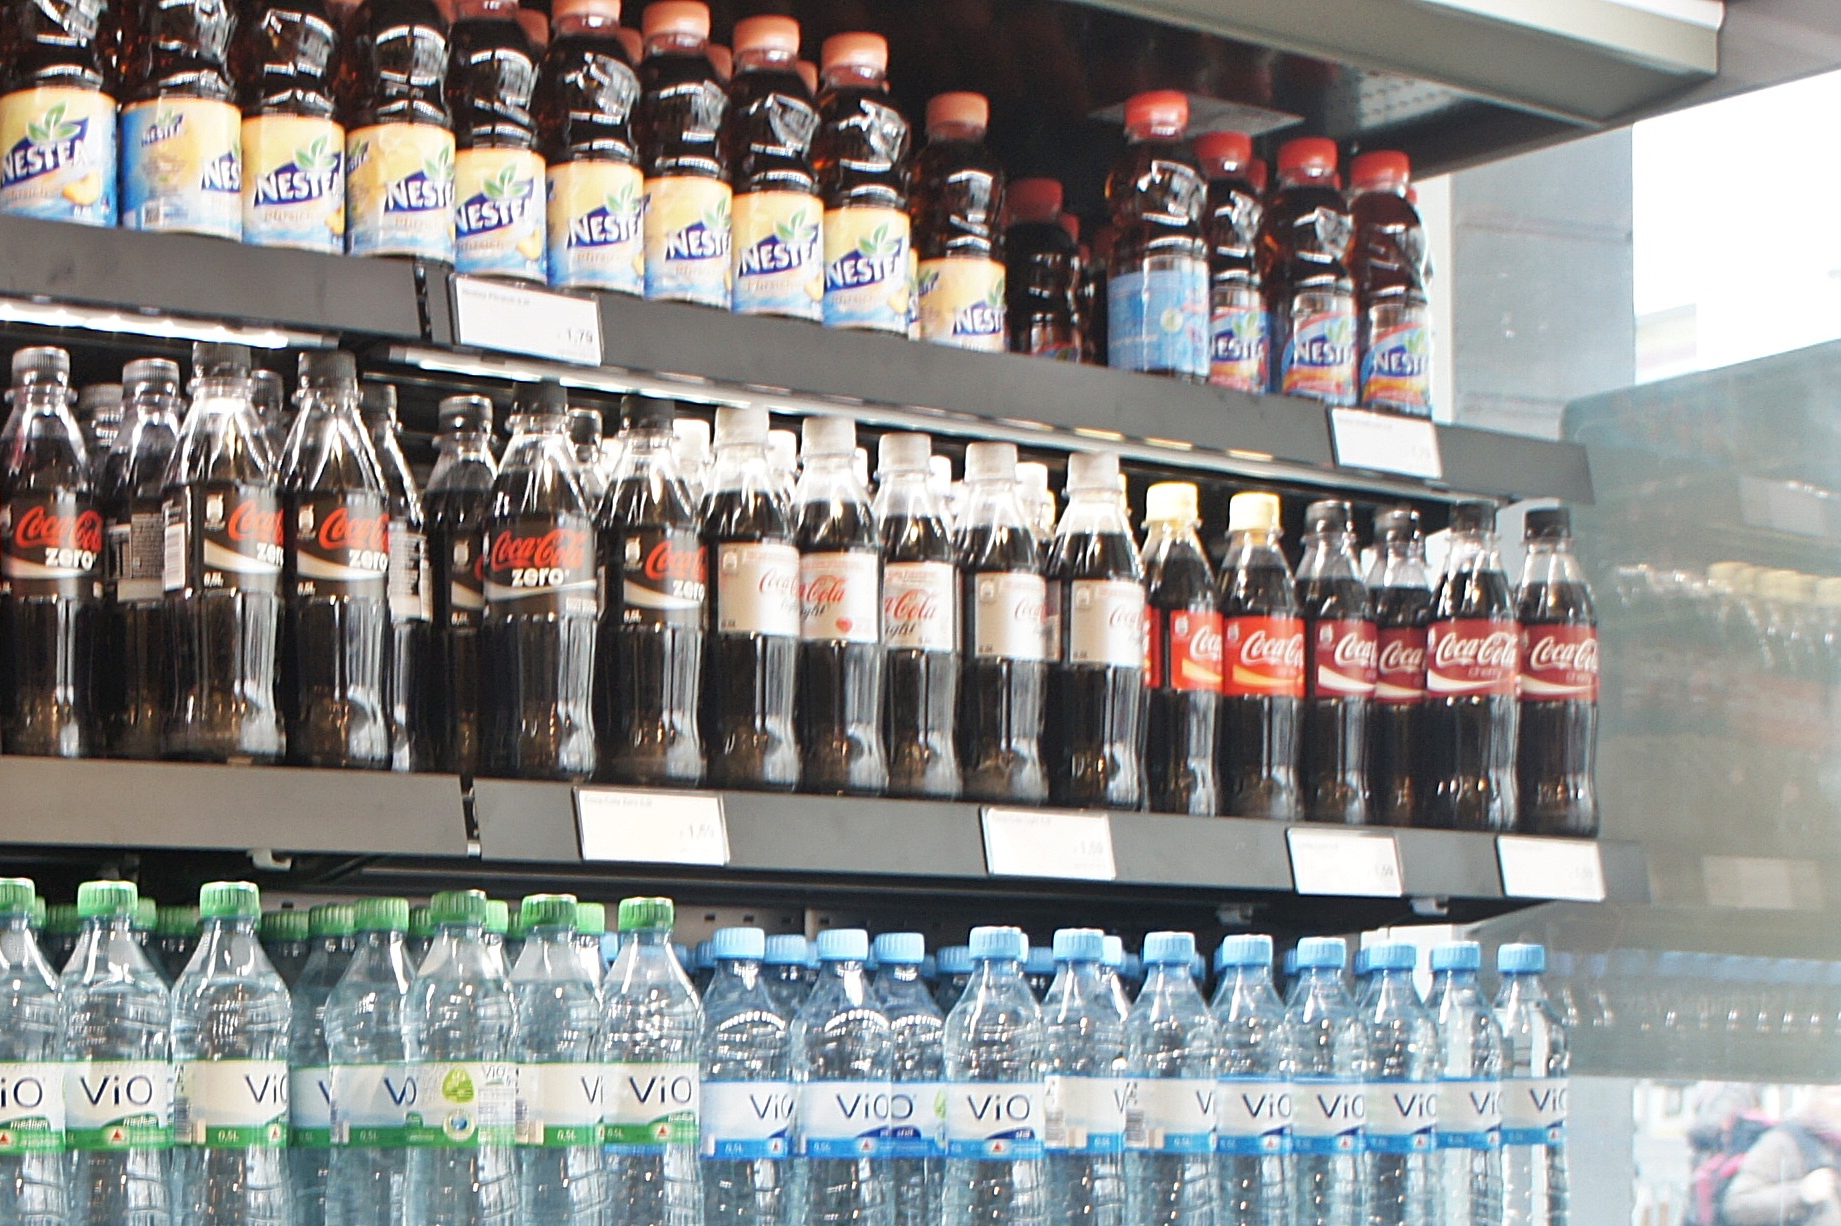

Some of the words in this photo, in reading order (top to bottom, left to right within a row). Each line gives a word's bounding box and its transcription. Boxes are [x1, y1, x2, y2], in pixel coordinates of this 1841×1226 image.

[15, 505, 103, 550] Coca-Cola
[45, 547, 96, 570] zero
[491, 529, 585, 573] Coca-Cola
[511, 566, 564, 588] zero
[80, 1074, 153, 1107] ViO
[628, 1075, 693, 1105] ViO
[967, 1093, 1031, 1122] ViO
